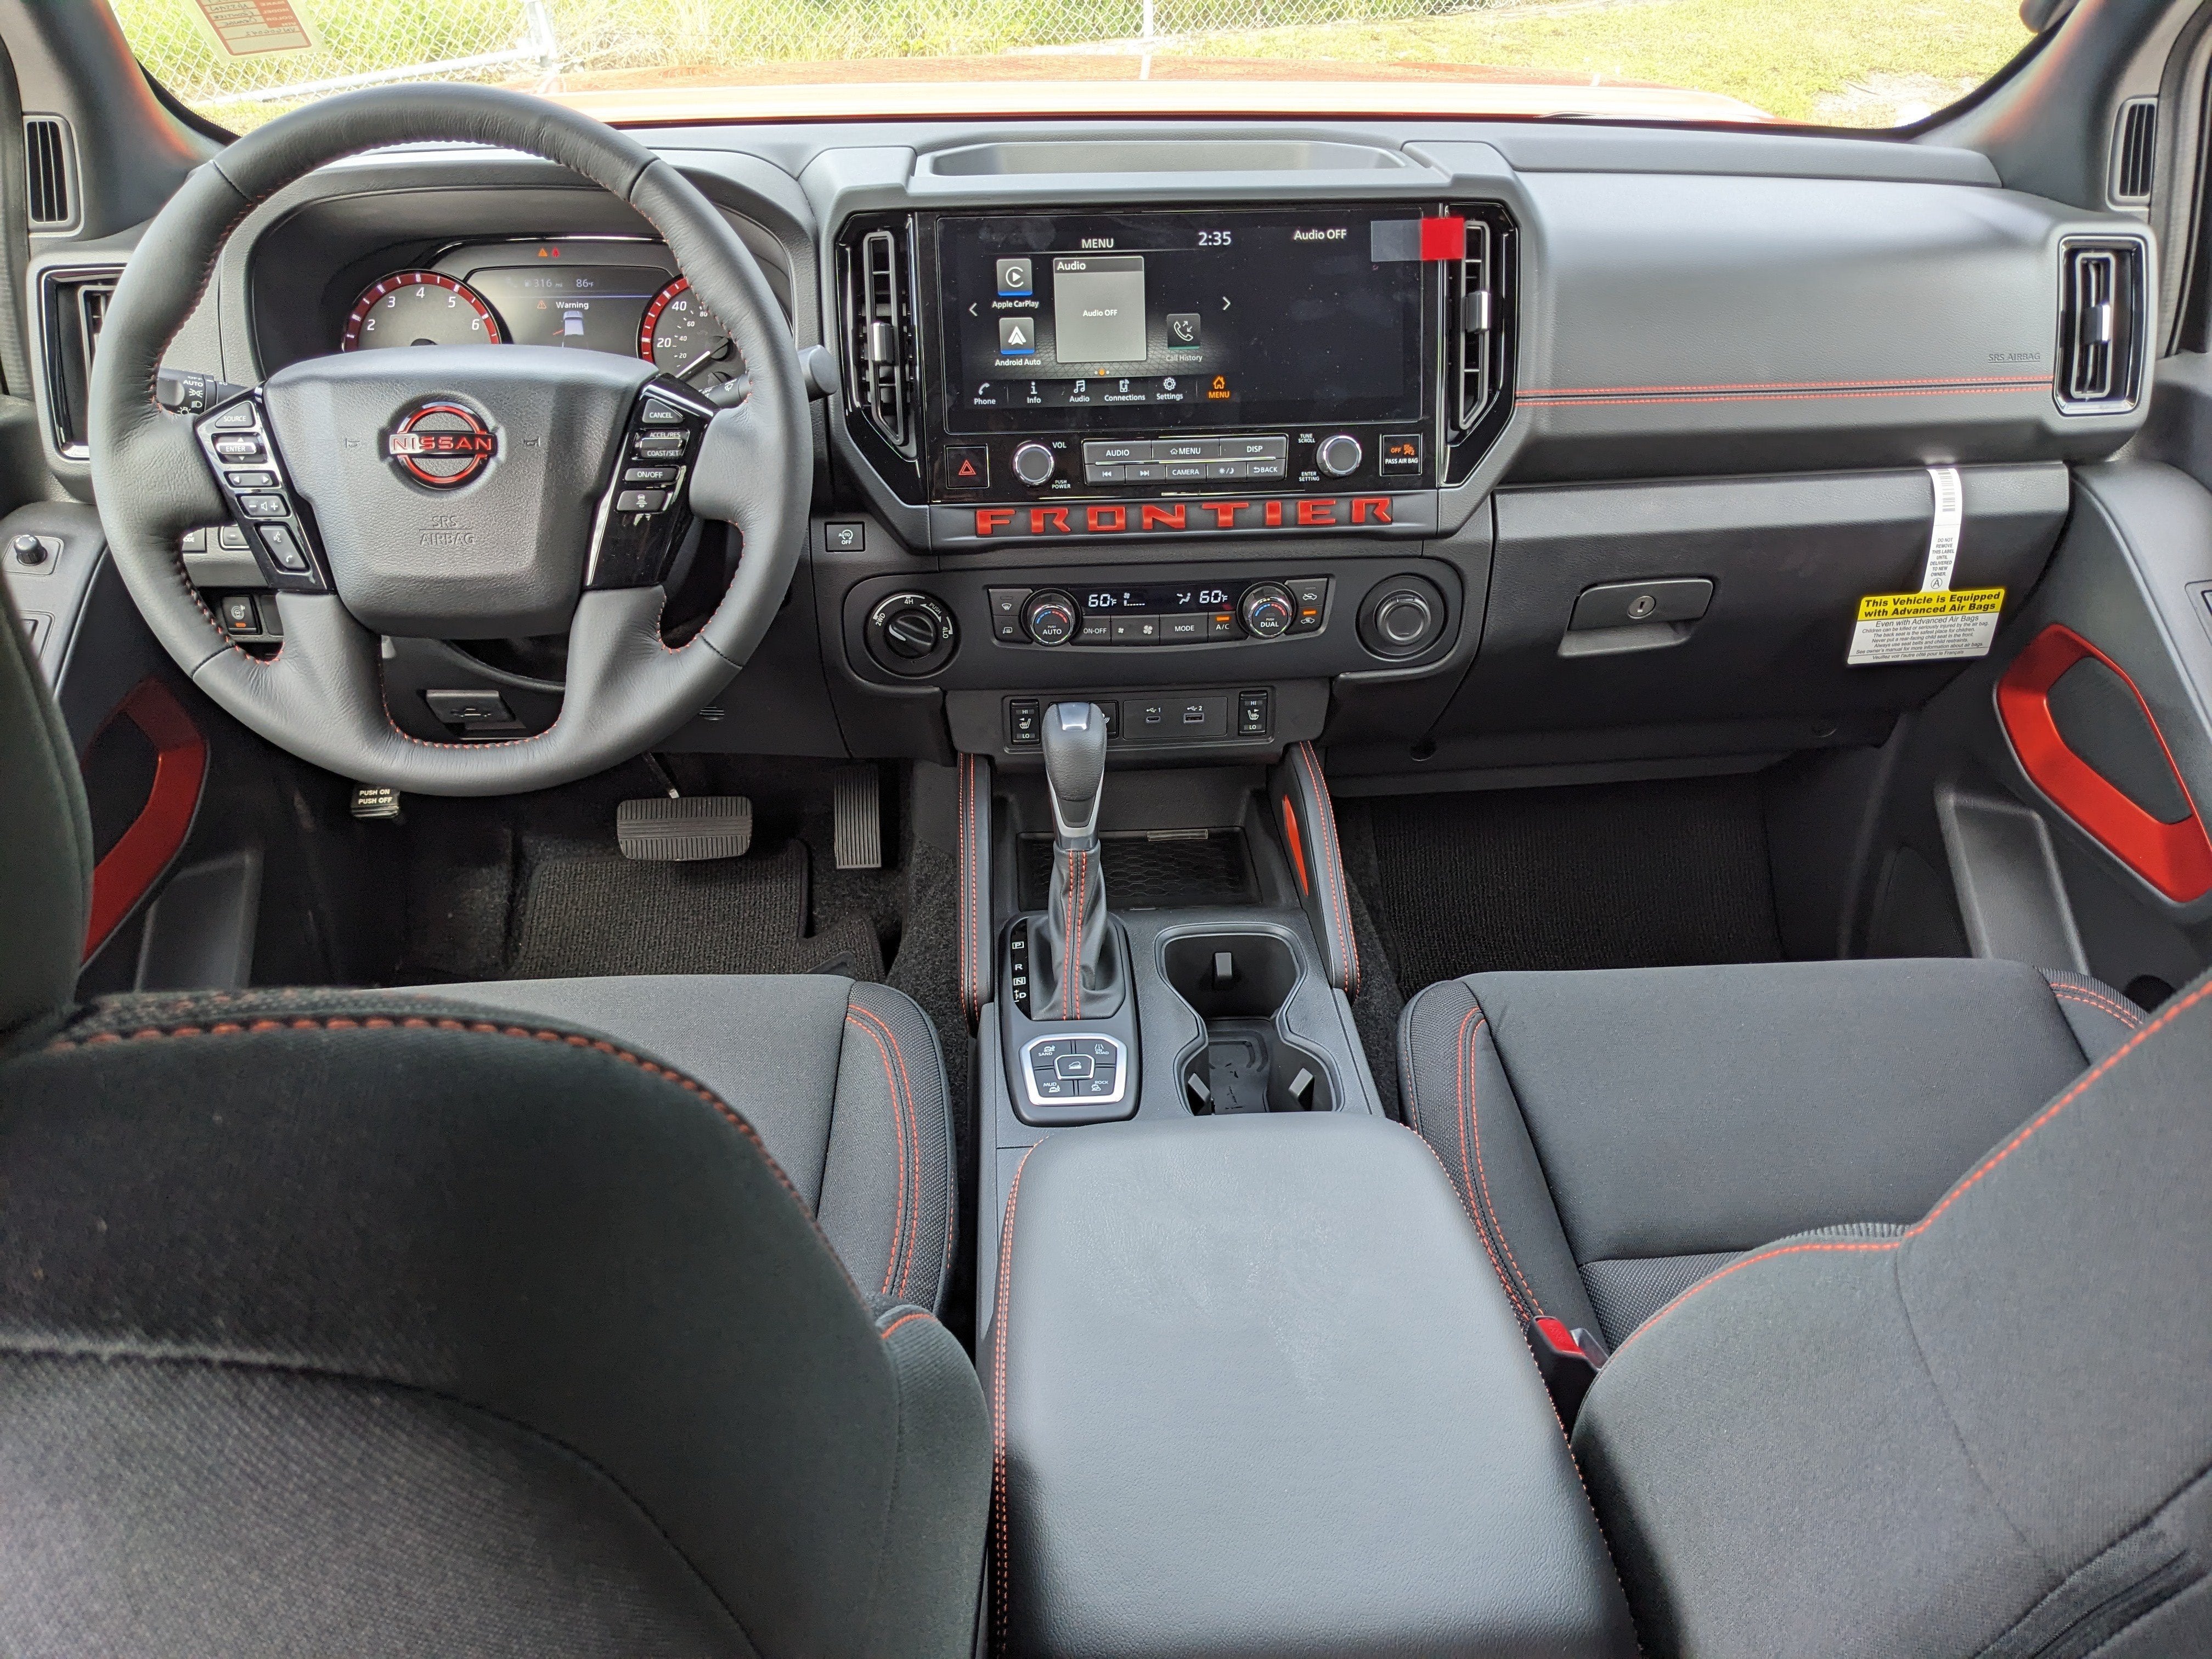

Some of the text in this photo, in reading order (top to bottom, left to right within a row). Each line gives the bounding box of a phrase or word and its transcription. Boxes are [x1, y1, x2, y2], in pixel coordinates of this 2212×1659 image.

[1198, 231, 1232, 246] 2:35
[1294, 229, 1347, 240] Audio OFF
[1082, 238, 1114, 249] MENU
[1057, 261, 1086, 271] Audio
[534, 279, 552, 287] 316
[416, 287, 425, 298] 4
[387, 296, 396, 307] 3
[448, 296, 456, 308] 5
[672, 301, 687, 311] 40
[992, 300, 1039, 309] Apple CarPlay
[367, 319, 375, 330] 2
[472, 319, 479, 330] 6
[657, 338, 672, 348] 20
[1988, 353, 2040, 362] SRS AIRBAG
[393, 437, 492, 450] NISSAN
[432, 516, 457, 528] SRS
[976, 498, 1392, 535] FRONTIER
[420, 533, 475, 545] AIRBAG
[1865, 599, 1888, 607] This
[1893, 596, 1933, 606] Vehicle
[1949, 591, 2000, 603] Equipped
[929, 602, 942, 614] PUSH
[1864, 603, 1996, 618] with Advanced Air Bags
[876, 612, 885, 627] 2WD
[1911, 617, 1948, 625] Advanced
